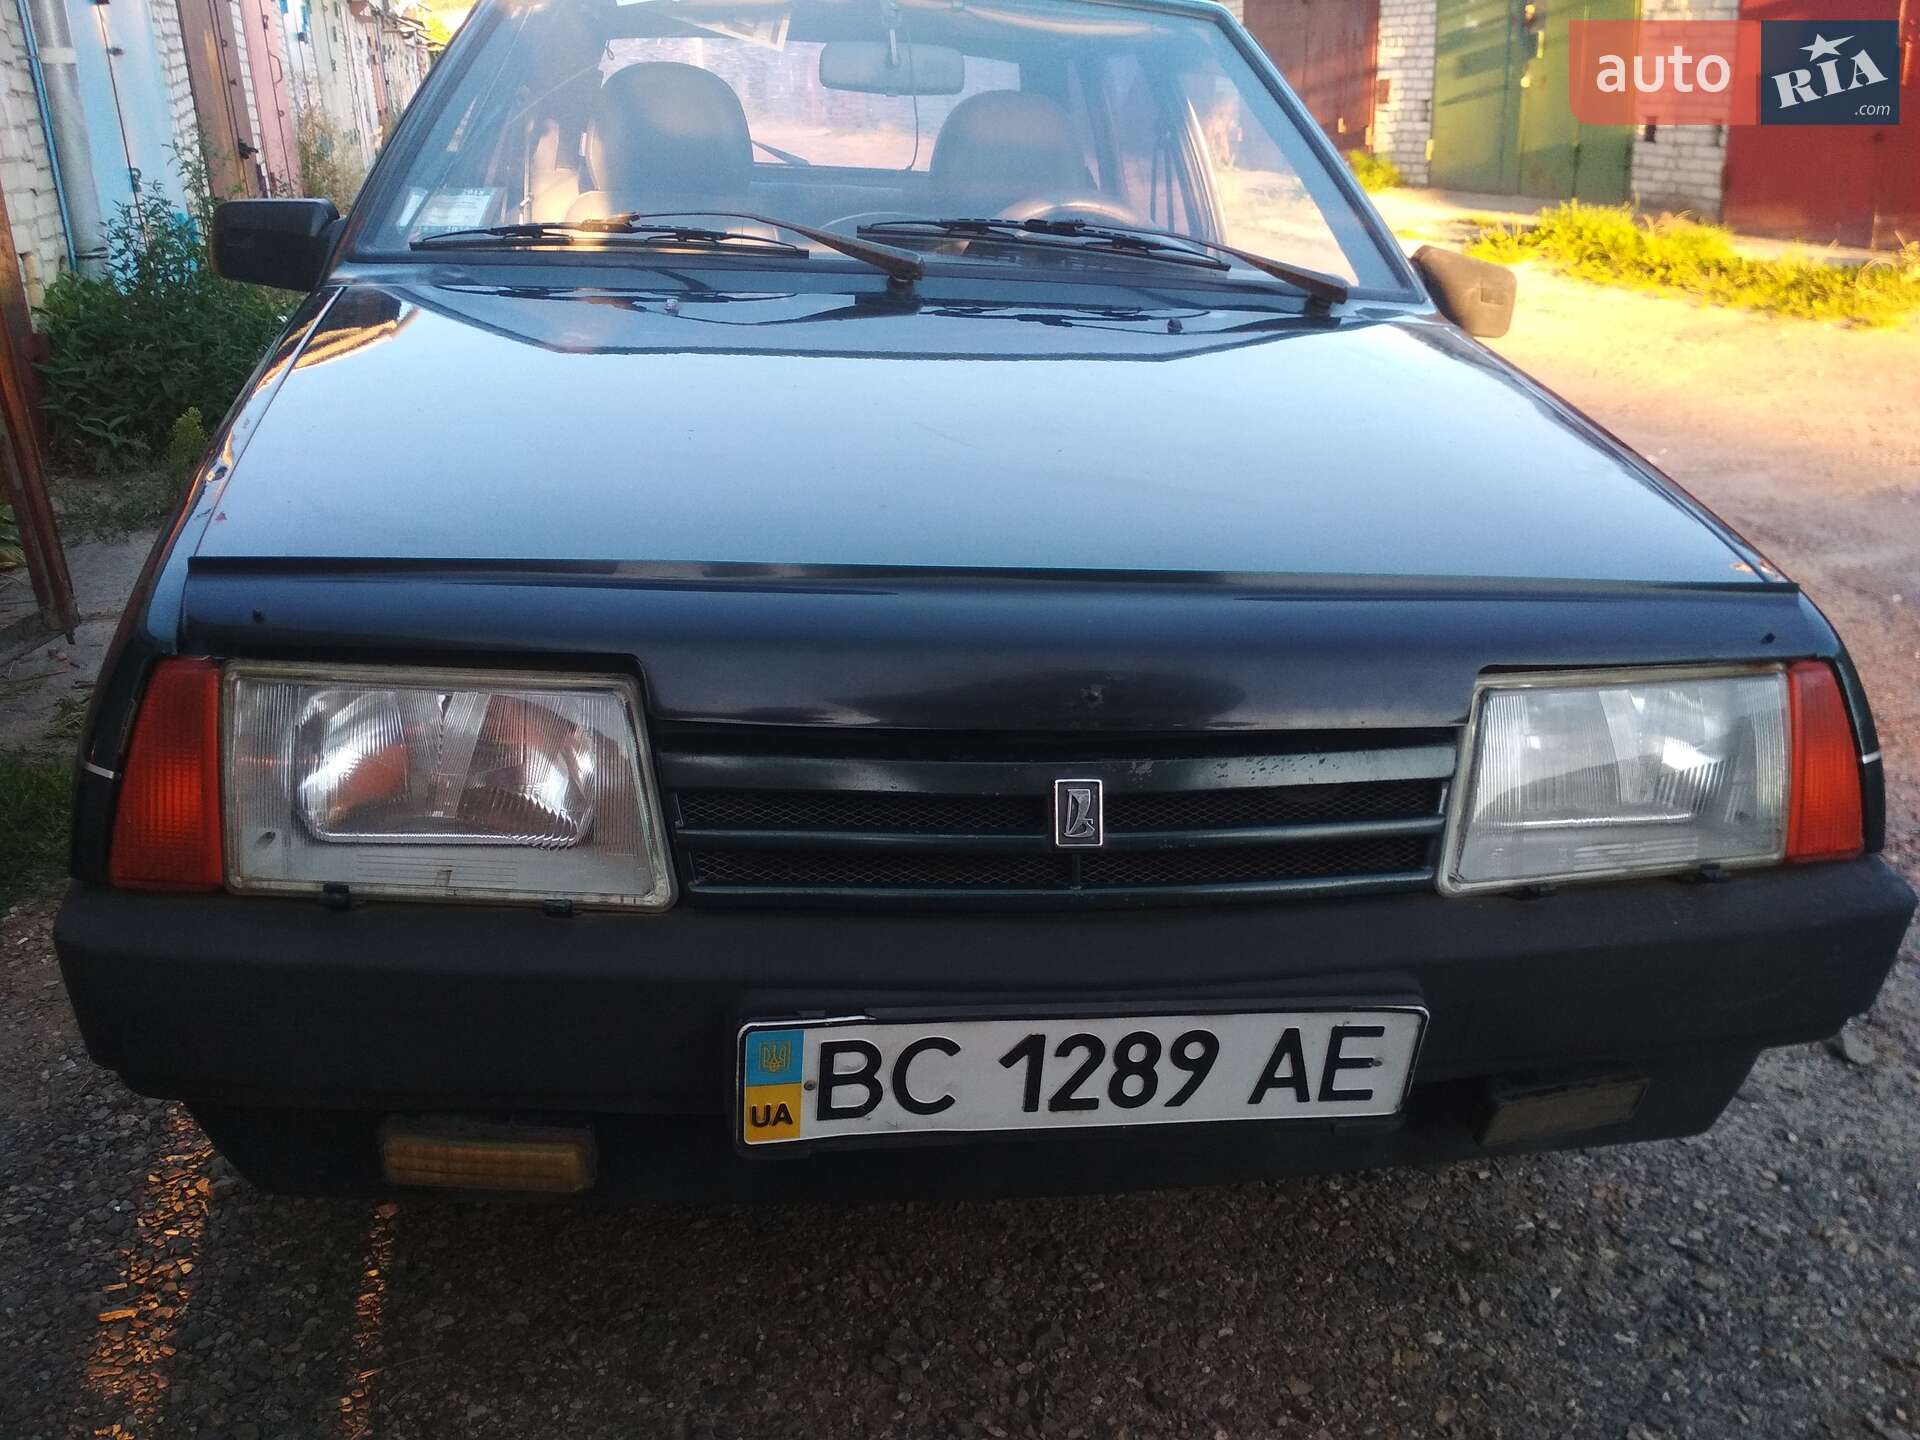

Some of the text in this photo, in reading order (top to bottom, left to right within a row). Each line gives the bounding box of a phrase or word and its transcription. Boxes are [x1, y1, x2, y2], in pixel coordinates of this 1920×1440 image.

[816, 1026, 1386, 1121] BC 1289 AE
[750, 1102, 794, 1128] UA
